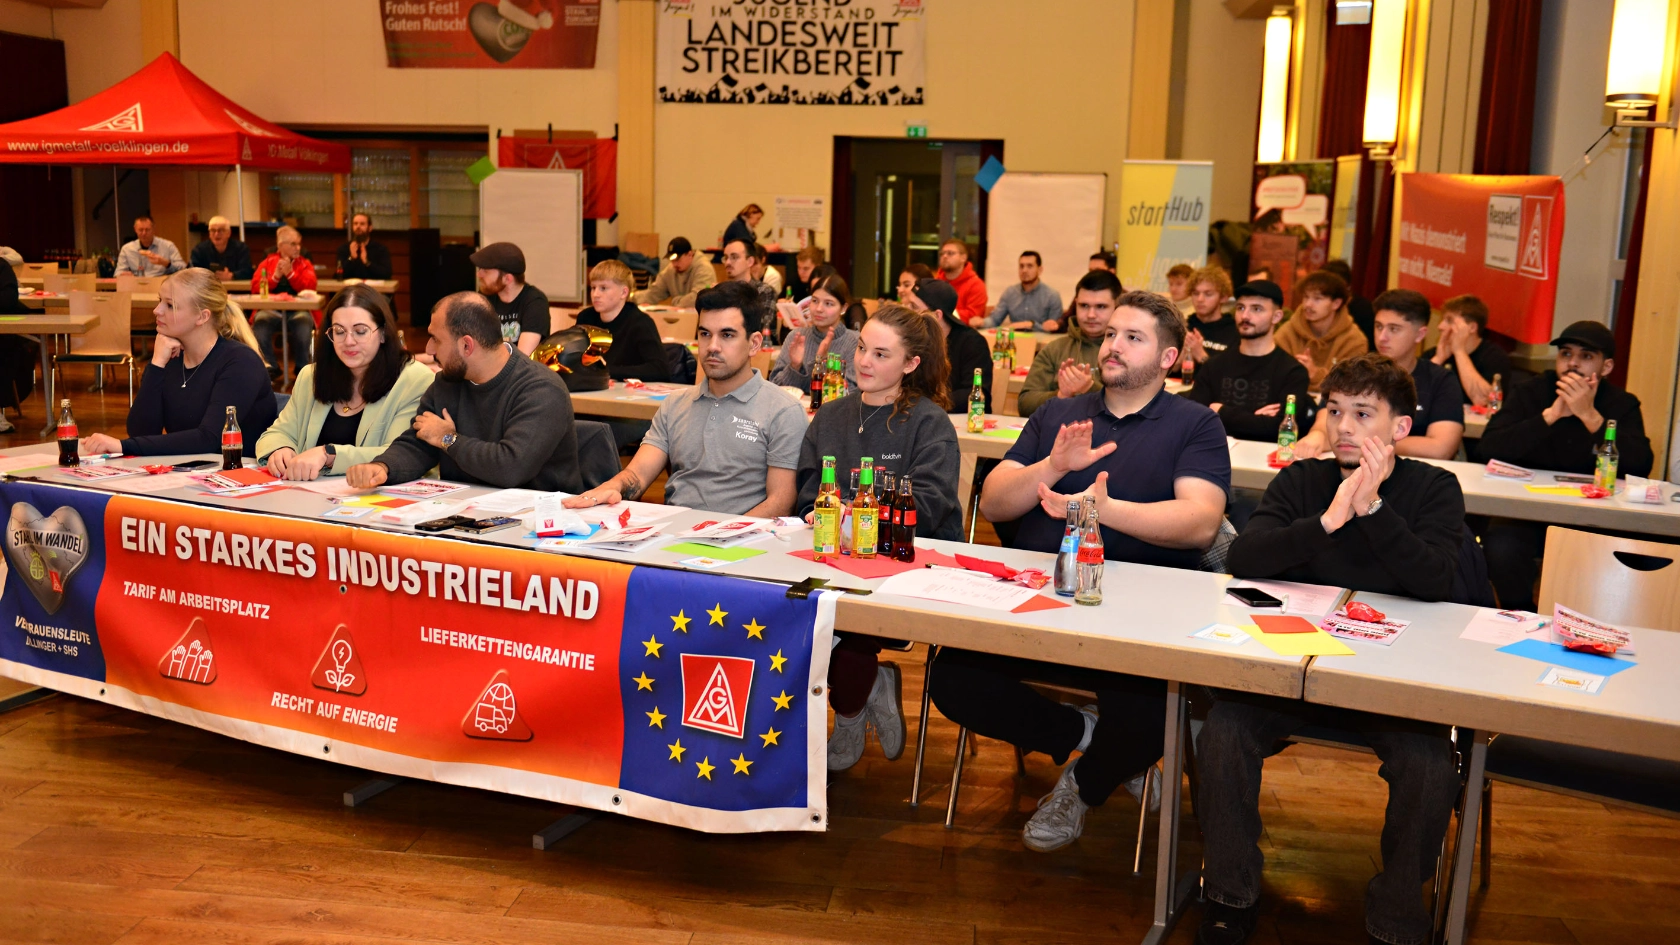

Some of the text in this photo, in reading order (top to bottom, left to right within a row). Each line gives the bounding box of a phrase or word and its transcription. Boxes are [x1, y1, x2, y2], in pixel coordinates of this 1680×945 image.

[385, 1, 459, 15] Frohes Fest!
[711, 5, 875, 20] IM WIDERSTAND
[386, 17, 467, 31] Guten Rutsch!
[687, 19, 899, 49] LANDESWEIT
[682, 47, 903, 77] STREIKBEREIT
[7, 139, 190, 155] www.igmetall-voelklingen.de
[1127, 195, 1204, 227] startHub
[1221, 376, 1270, 392] BOSS
[735, 430, 758, 443] Koray
[34, 531, 44, 546] IM
[45, 532, 82, 555] WANDEL
[121, 516, 600, 620] EIN STARKES INDUSTRIELAND
[123, 581, 270, 620] TARIF AM ARBEITSPLATZ
[15, 615, 92, 645] VERAUENSLEUTE
[63, 644, 79, 657] SHS
[419, 625, 596, 671] LIEFERKETTENGARANTIE
[271, 692, 399, 734] RECHT AUF ENERGIE
